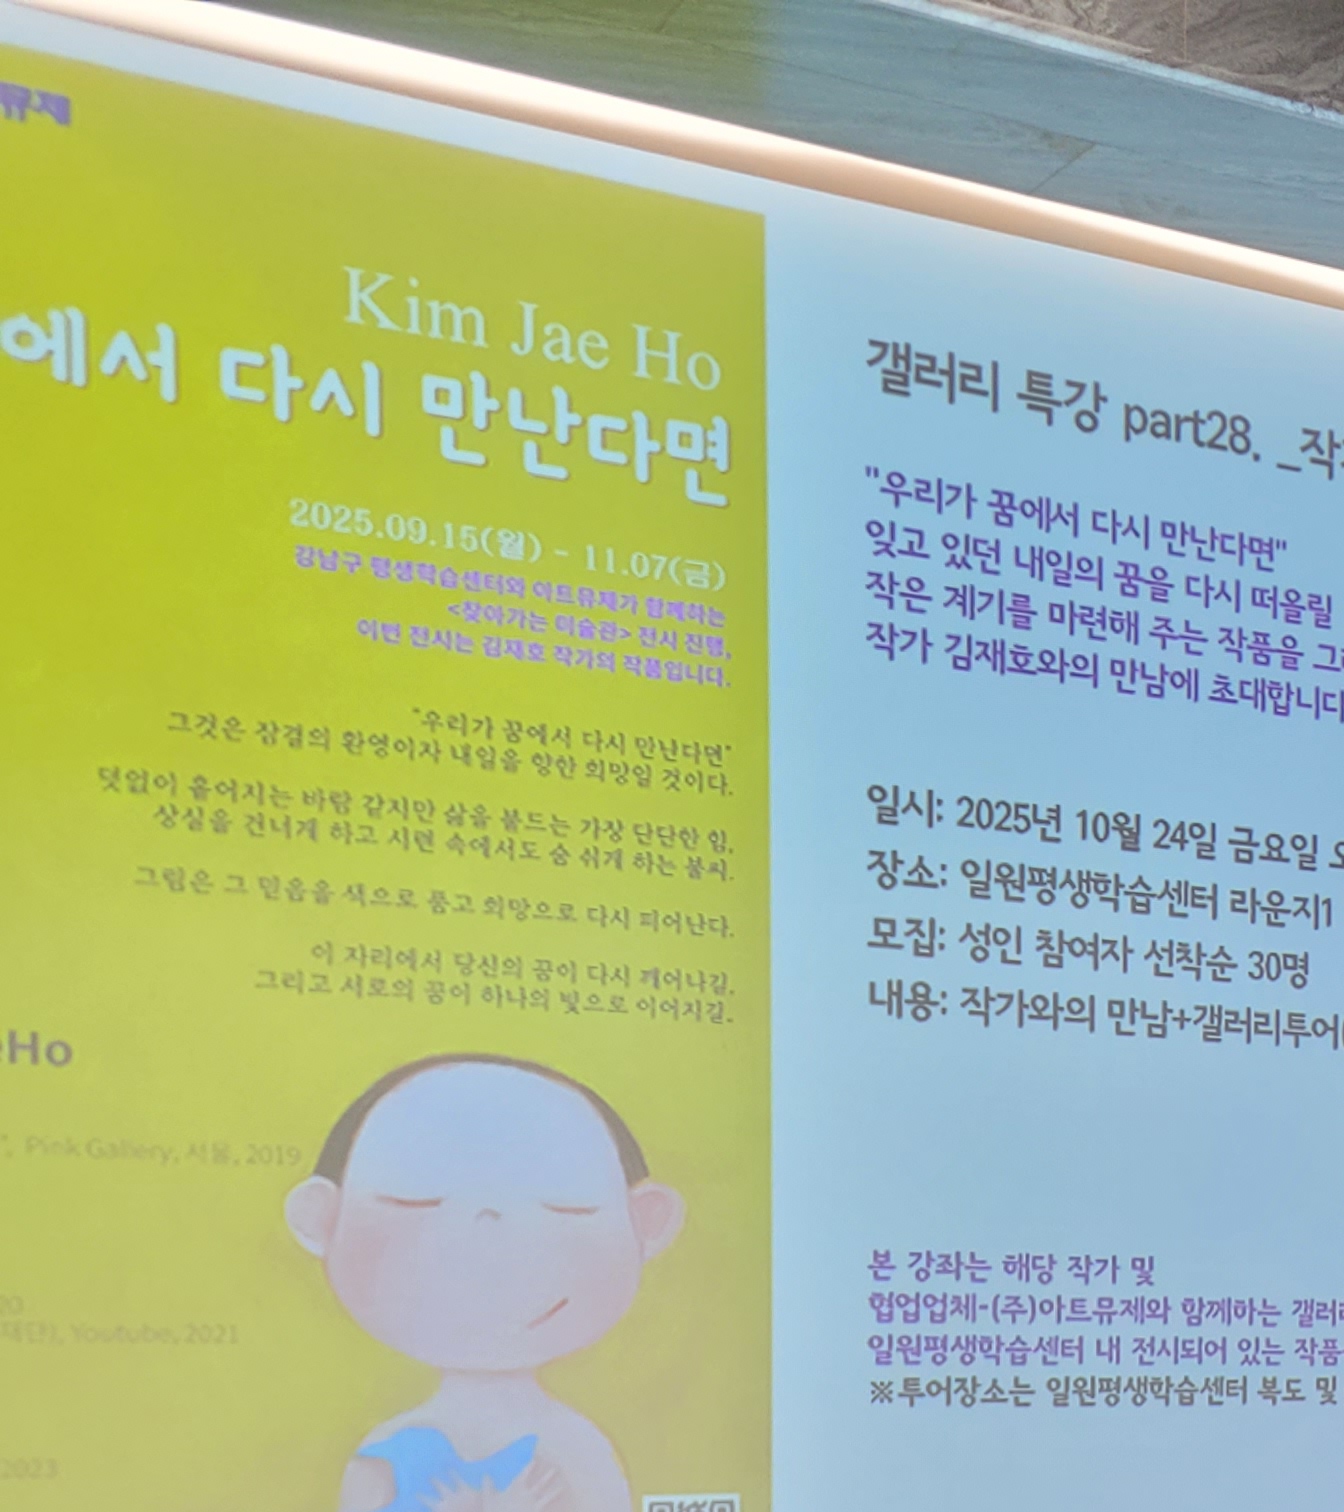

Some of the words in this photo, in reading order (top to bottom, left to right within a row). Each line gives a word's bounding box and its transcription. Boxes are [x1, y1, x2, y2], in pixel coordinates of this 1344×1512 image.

[345, 267, 486, 347] Kim
[511, 302, 608, 370] Jae
[634, 325, 721, 390] Ho
[0, 307, 180, 404] 에서
[220, 344, 384, 439] 다시
[422, 371, 731, 508] 만난다면
[866, 339, 999, 413] 갤러리
[1016, 370, 1108, 433] 특강
[1124, 404, 1261, 462] part28.
[289, 498, 542, 562] 2025.09.15(월)
[586, 545, 725, 591] 11.07(금)
[987, 489, 1079, 538] 꿈에서
[1092, 509, 1150, 550] 다시
[865, 520, 930, 559] 잊고
[941, 533, 1001, 576] 있던
[1014, 546, 1104, 591] 내일의
[1114, 561, 1174, 604] 꿈을
[1185, 575, 1241, 613] 다시
[1251, 586, 1332, 630] 떠올릴
[866, 571, 933, 614] 작은
[943, 585, 1037, 631] 계기를
[1049, 601, 1139, 645] 마련해
[1149, 616, 1208, 656] 주는
[1218, 627, 1304, 671] 작품을
[866, 622, 933, 664] 작가
[945, 634, 1099, 689] 김재호와의
[1110, 659, 1199, 703] 만남에
[867, 784, 943, 829] 일시:
[956, 796, 1062, 844] 2025년
[1076, 809, 1141, 853] 10월
[1153, 818, 1217, 861] 24일
[1228, 826, 1318, 872] 금요일
[867, 850, 947, 891] 장소:
[960, 859, 1218, 921] 일원평생학습센터
[1230, 887, 1332, 930] 라운지1
[867, 917, 945, 958] 모집:
[959, 923, 1022, 966] 성인
[1036, 929, 1134, 974] 참여자
[1144, 939, 1238, 983] 선착순
[1248, 950, 1309, 990] 30명
[869, 979, 947, 1023] 내용:
[960, 986, 1095, 1033] 작가와의
[25, 1135, 81, 1157] Pink
[245, 1144, 302, 1166] 2019
[868, 1250, 896, 1282] 본
[908, 1250, 992, 1284] 강좌는
[1002, 1253, 1057, 1285] 해당
[1068, 1255, 1120, 1285] 작가
[1131, 1256, 1154, 1286] 및
[184, 1322, 239, 1345] 2021
[868, 1292, 1172, 1325] 협업업체-(주)아트뮤제와
[1181, 1297, 1282, 1328] 함께하는
[867, 1334, 1084, 1367] 일원평생학습센터
[1096, 1336, 1121, 1365] 내
[1132, 1336, 1227, 1367] 전시되어
[1237, 1337, 1285, 1367] 있는
[1046, 1375, 1247, 1408] 일원평생학습센터
[1257, 1376, 1306, 1406] 복도
[1316, 1375, 1337, 1406] 및
